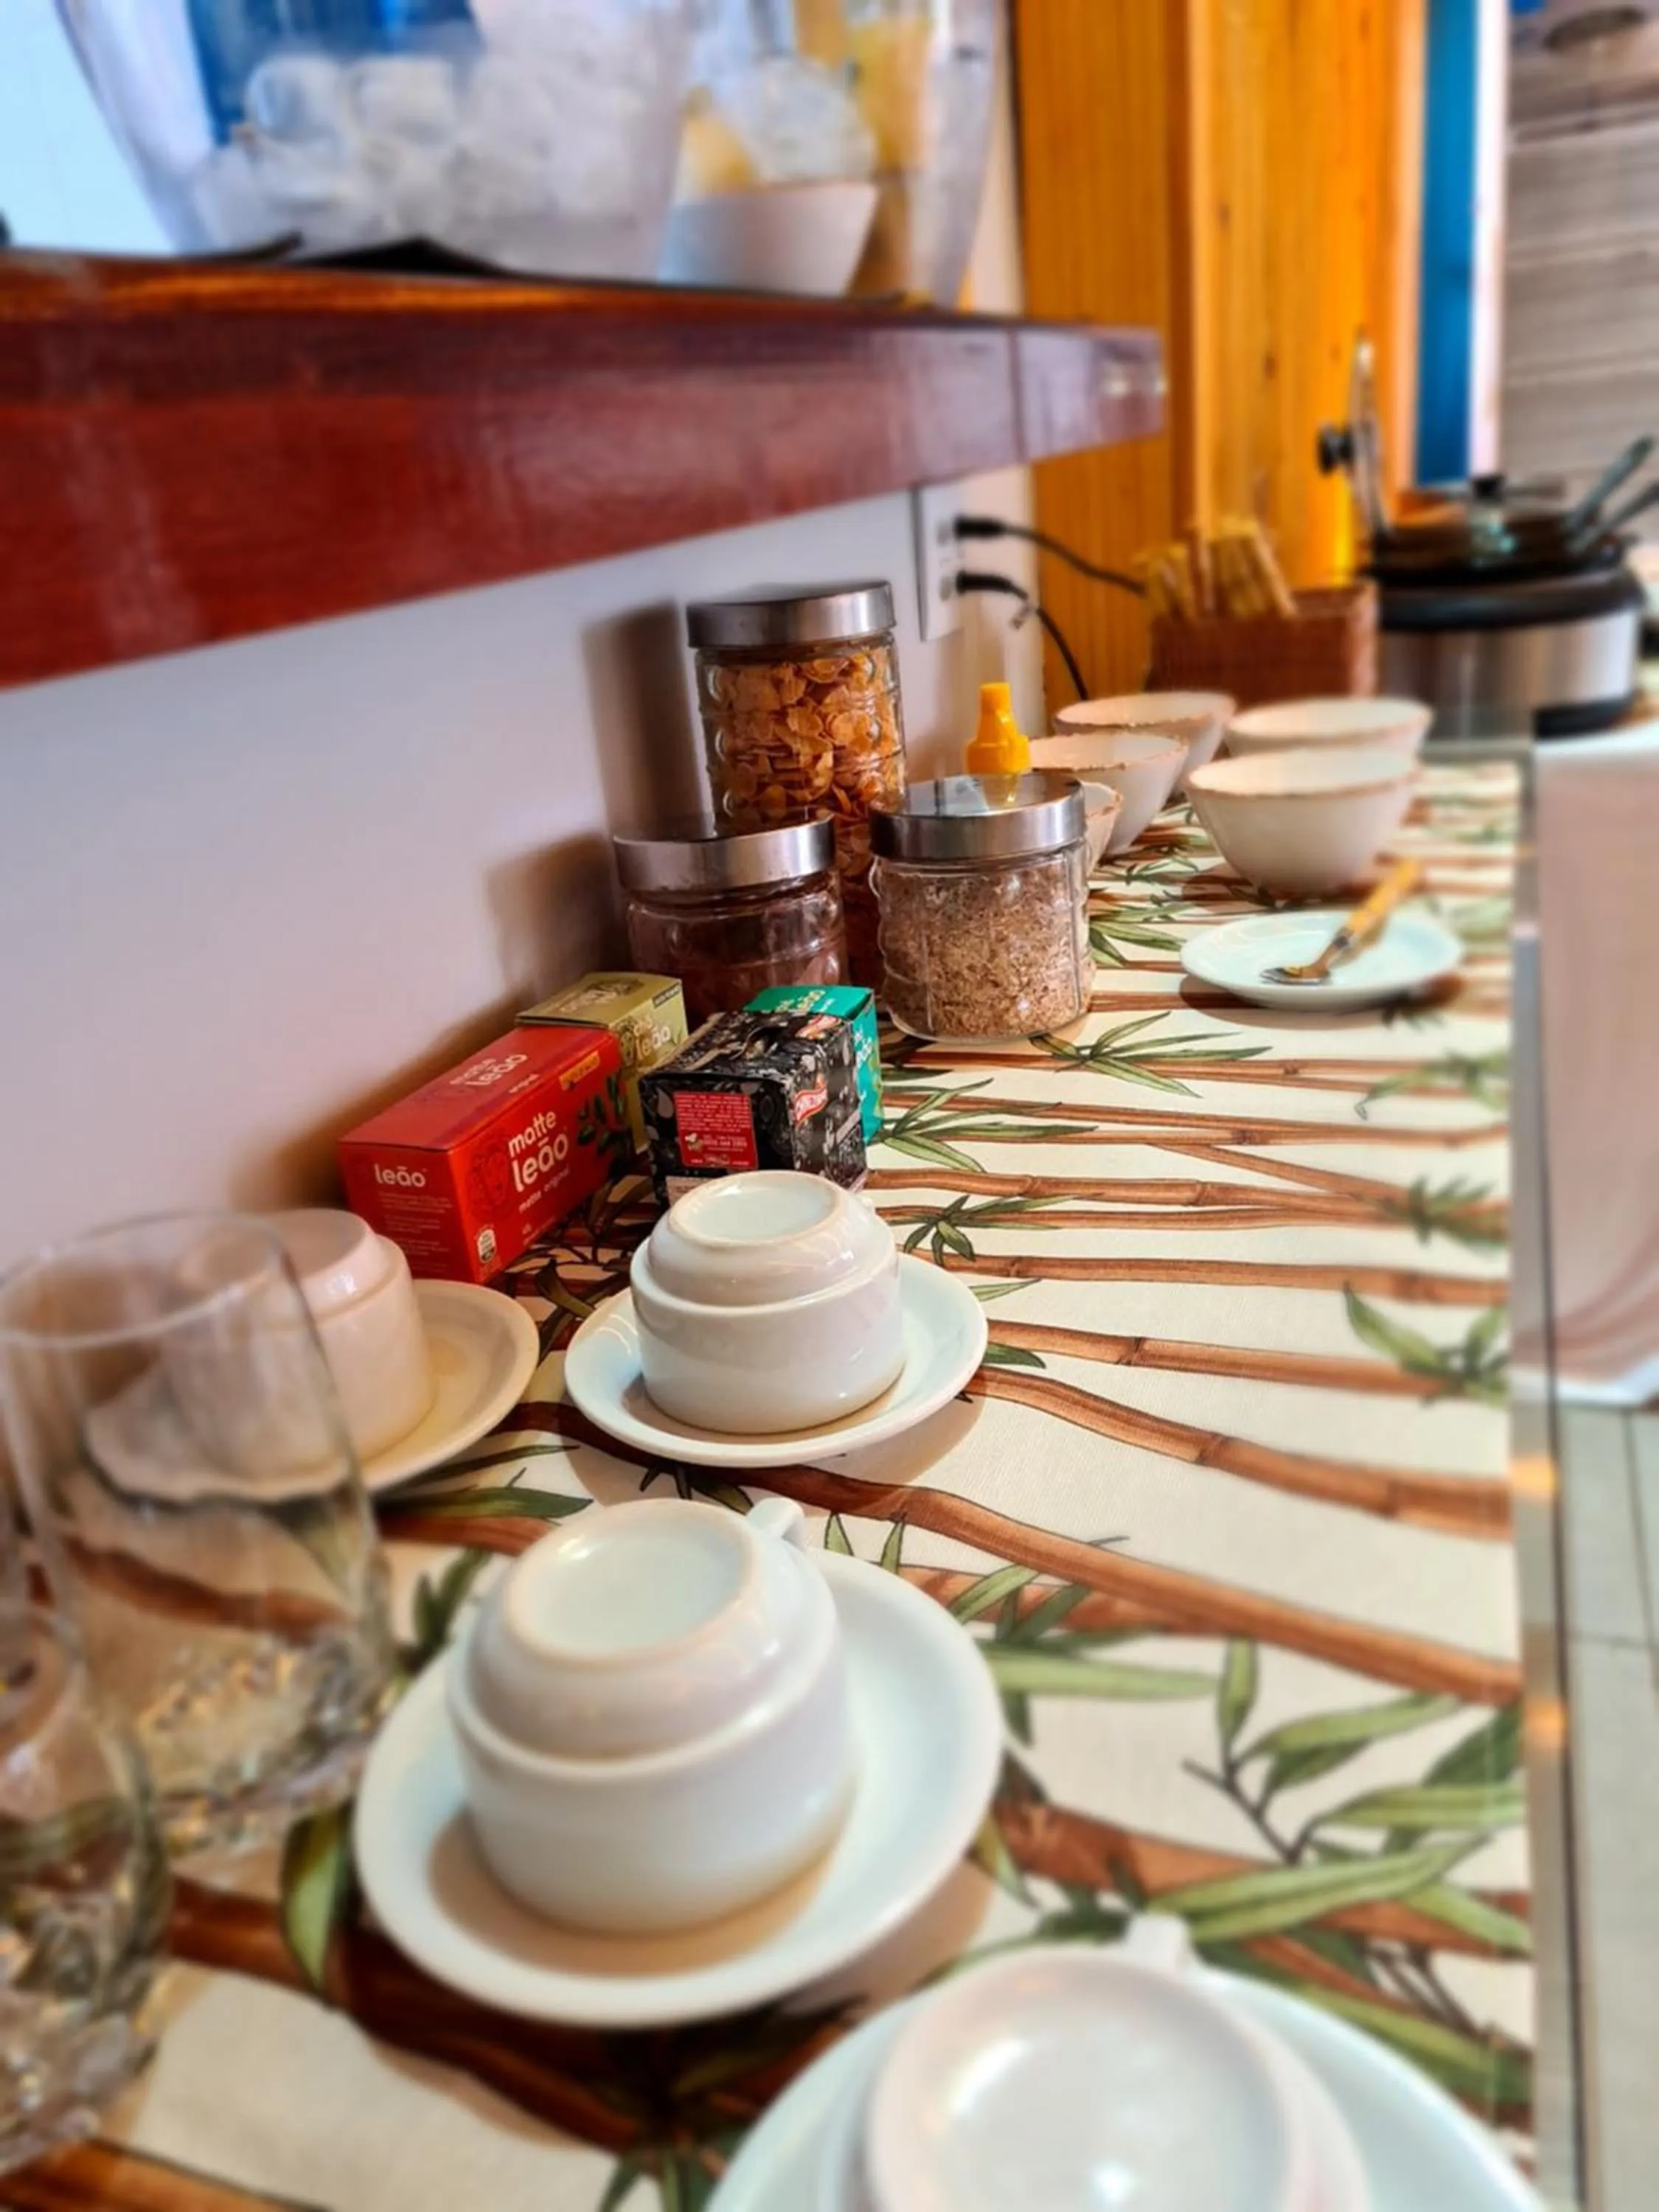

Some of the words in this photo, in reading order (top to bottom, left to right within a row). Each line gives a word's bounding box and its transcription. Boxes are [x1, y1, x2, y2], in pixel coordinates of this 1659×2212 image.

[509, 1111, 557, 1158] matte
[375, 1163, 426, 1188] leão
[512, 1133, 568, 1192] leão
